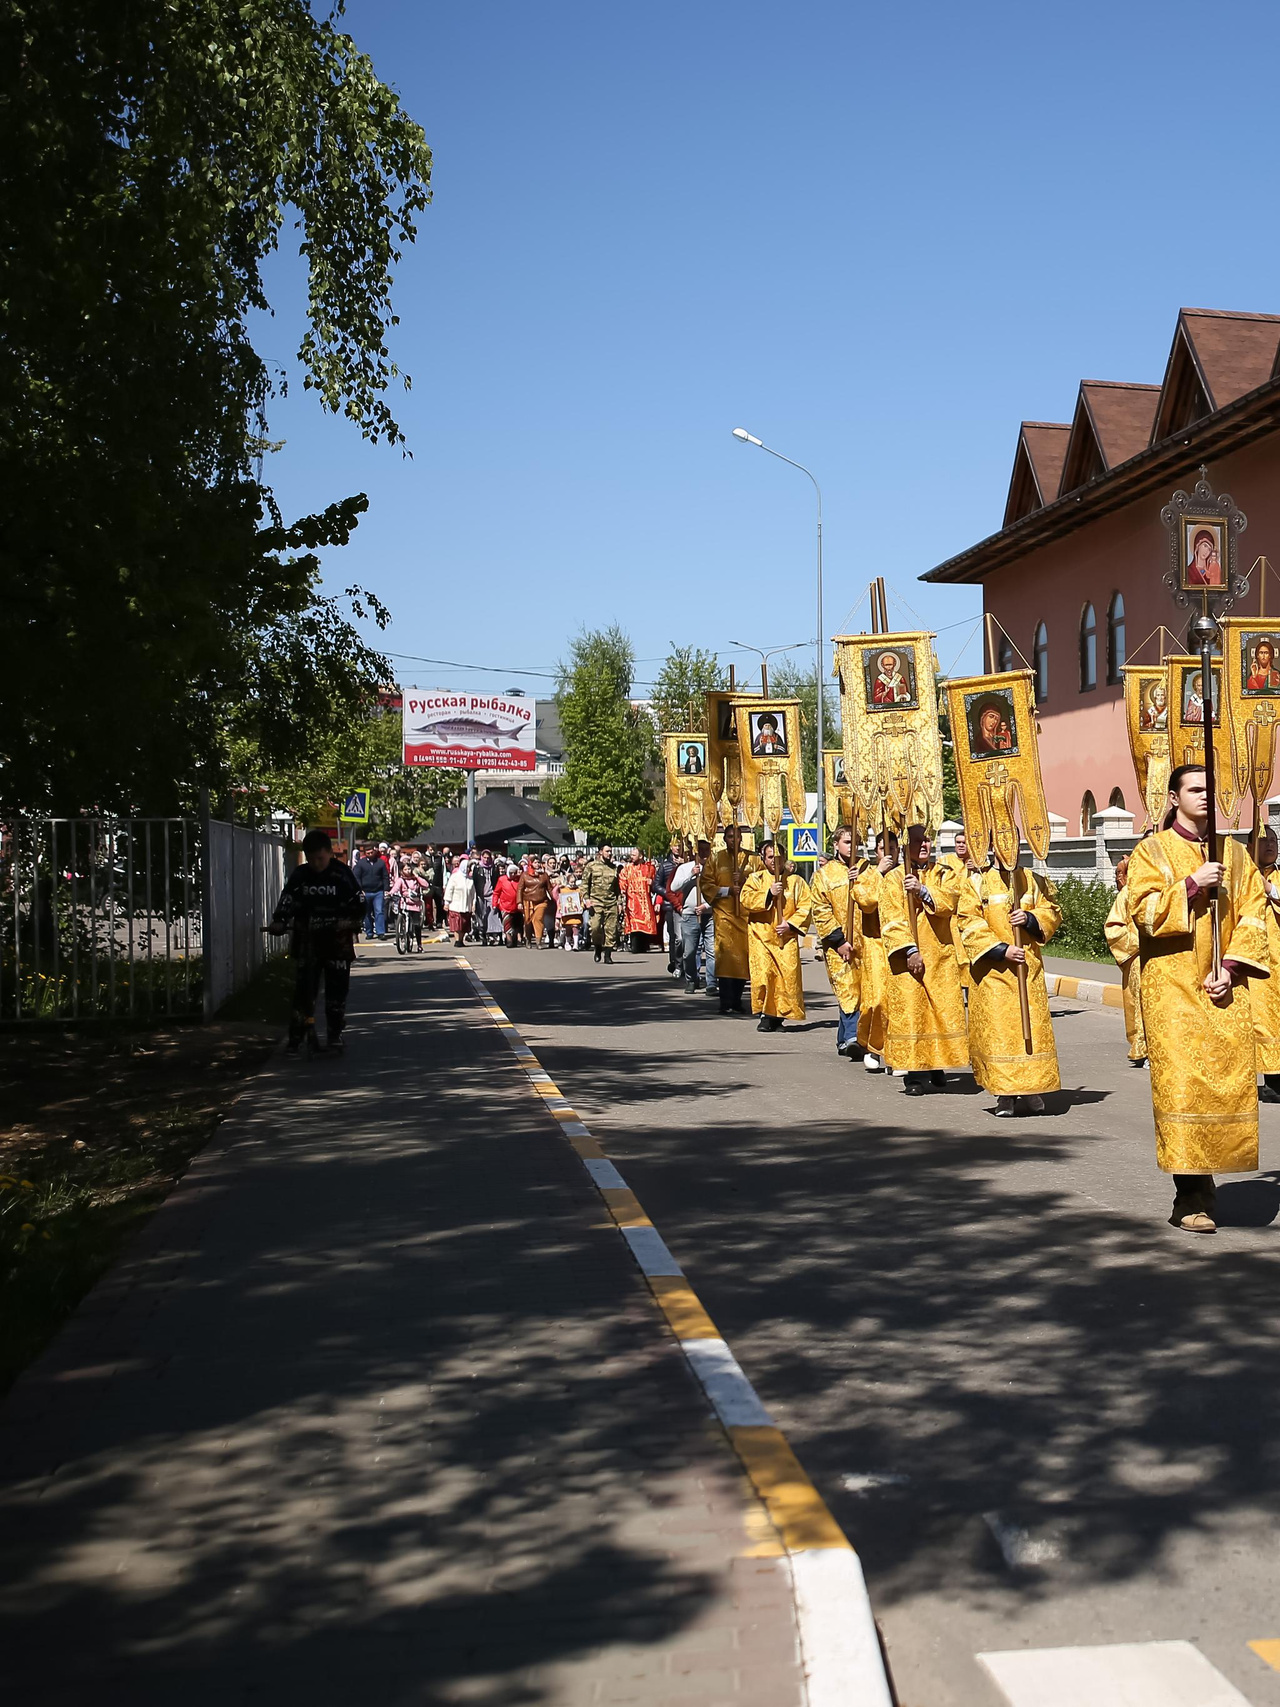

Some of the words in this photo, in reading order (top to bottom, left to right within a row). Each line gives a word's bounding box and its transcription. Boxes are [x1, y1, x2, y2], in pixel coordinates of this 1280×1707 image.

[409, 697, 467, 714] Русская
[471, 698, 531, 721] рыбалка
[427, 710, 451, 719] ресторан
[489, 712, 515, 723] гостиница
[430, 749, 512, 758] www.russkaya-rybalka.com
[303, 886, 336, 896] BOOM
